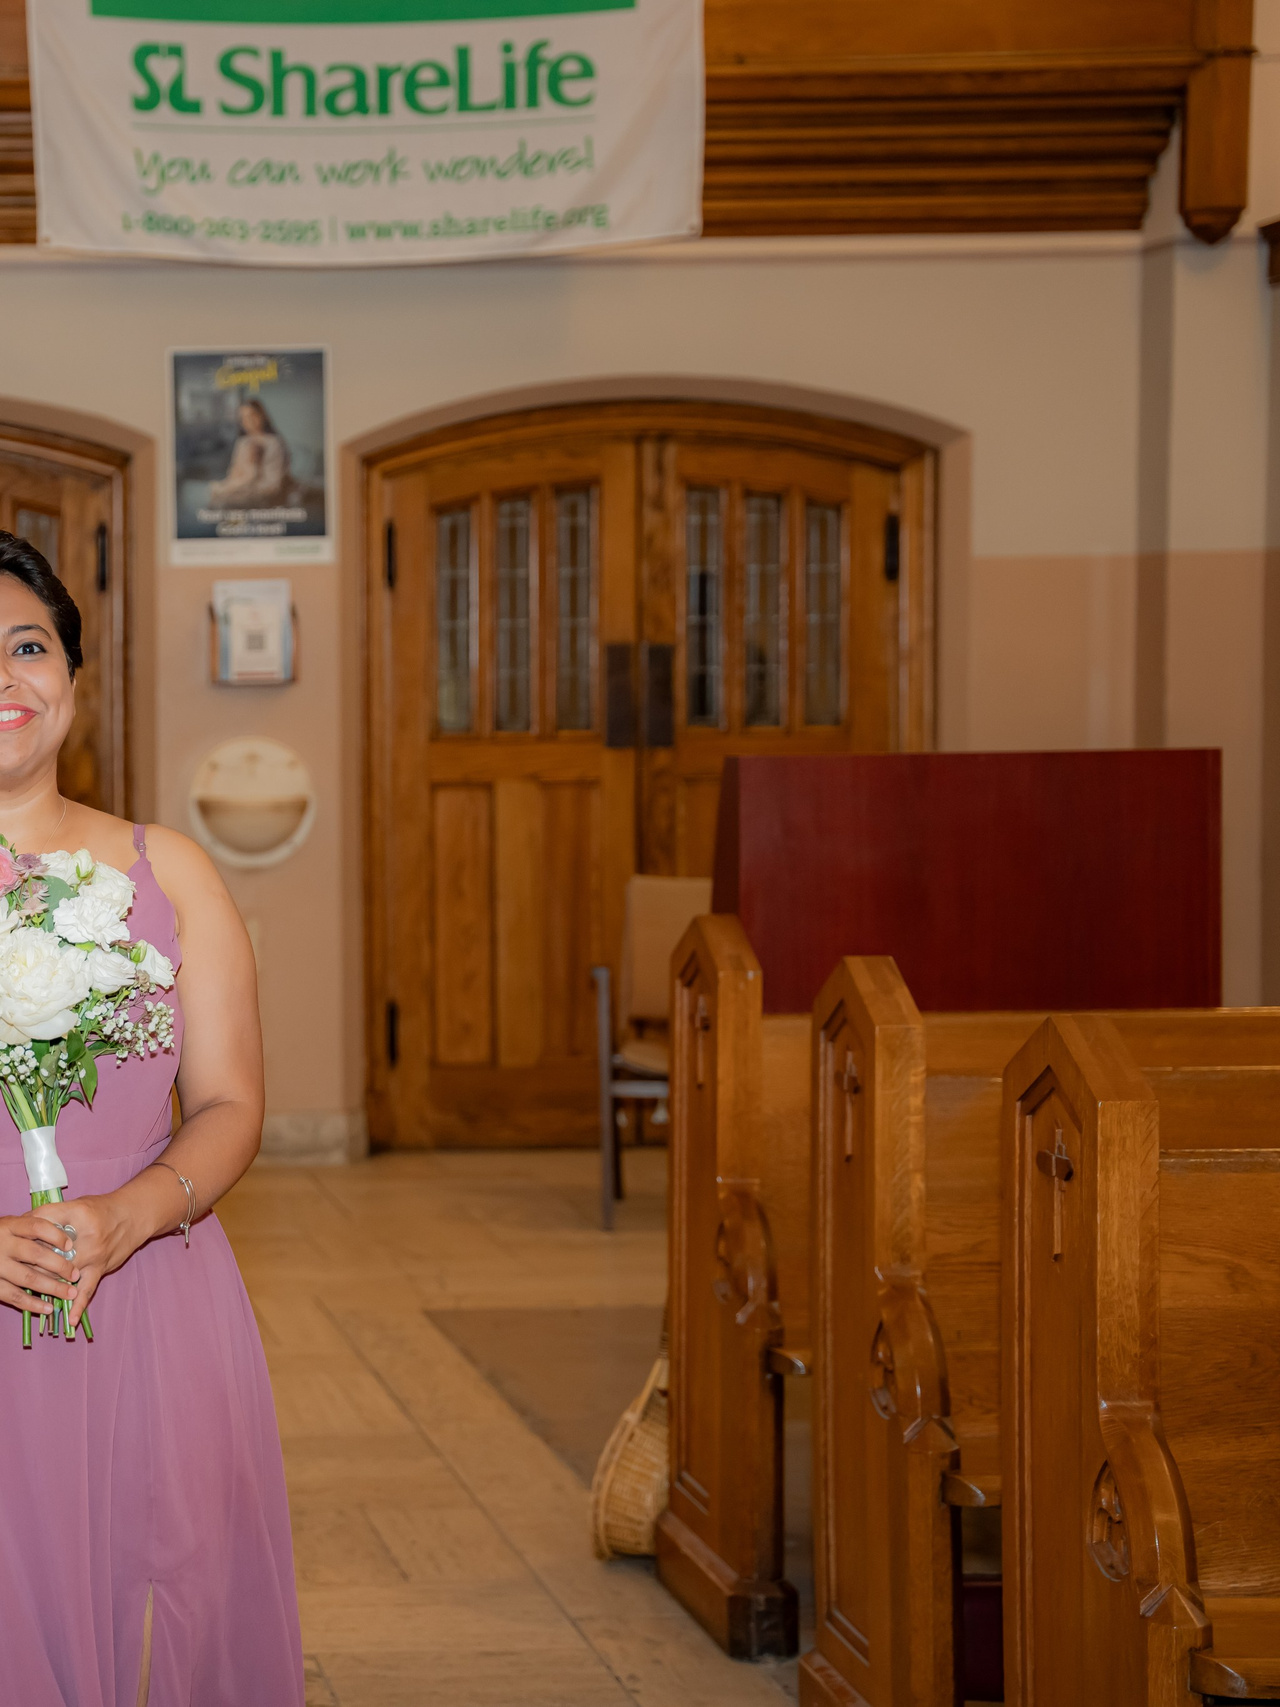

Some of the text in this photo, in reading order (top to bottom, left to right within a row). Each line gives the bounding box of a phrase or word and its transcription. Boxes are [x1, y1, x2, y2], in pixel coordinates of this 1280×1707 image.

[218, 39, 596, 117] ShareLife
[133, 136, 596, 194] You can work wonders!
[345, 204, 609, 241] www.sharelife.org
